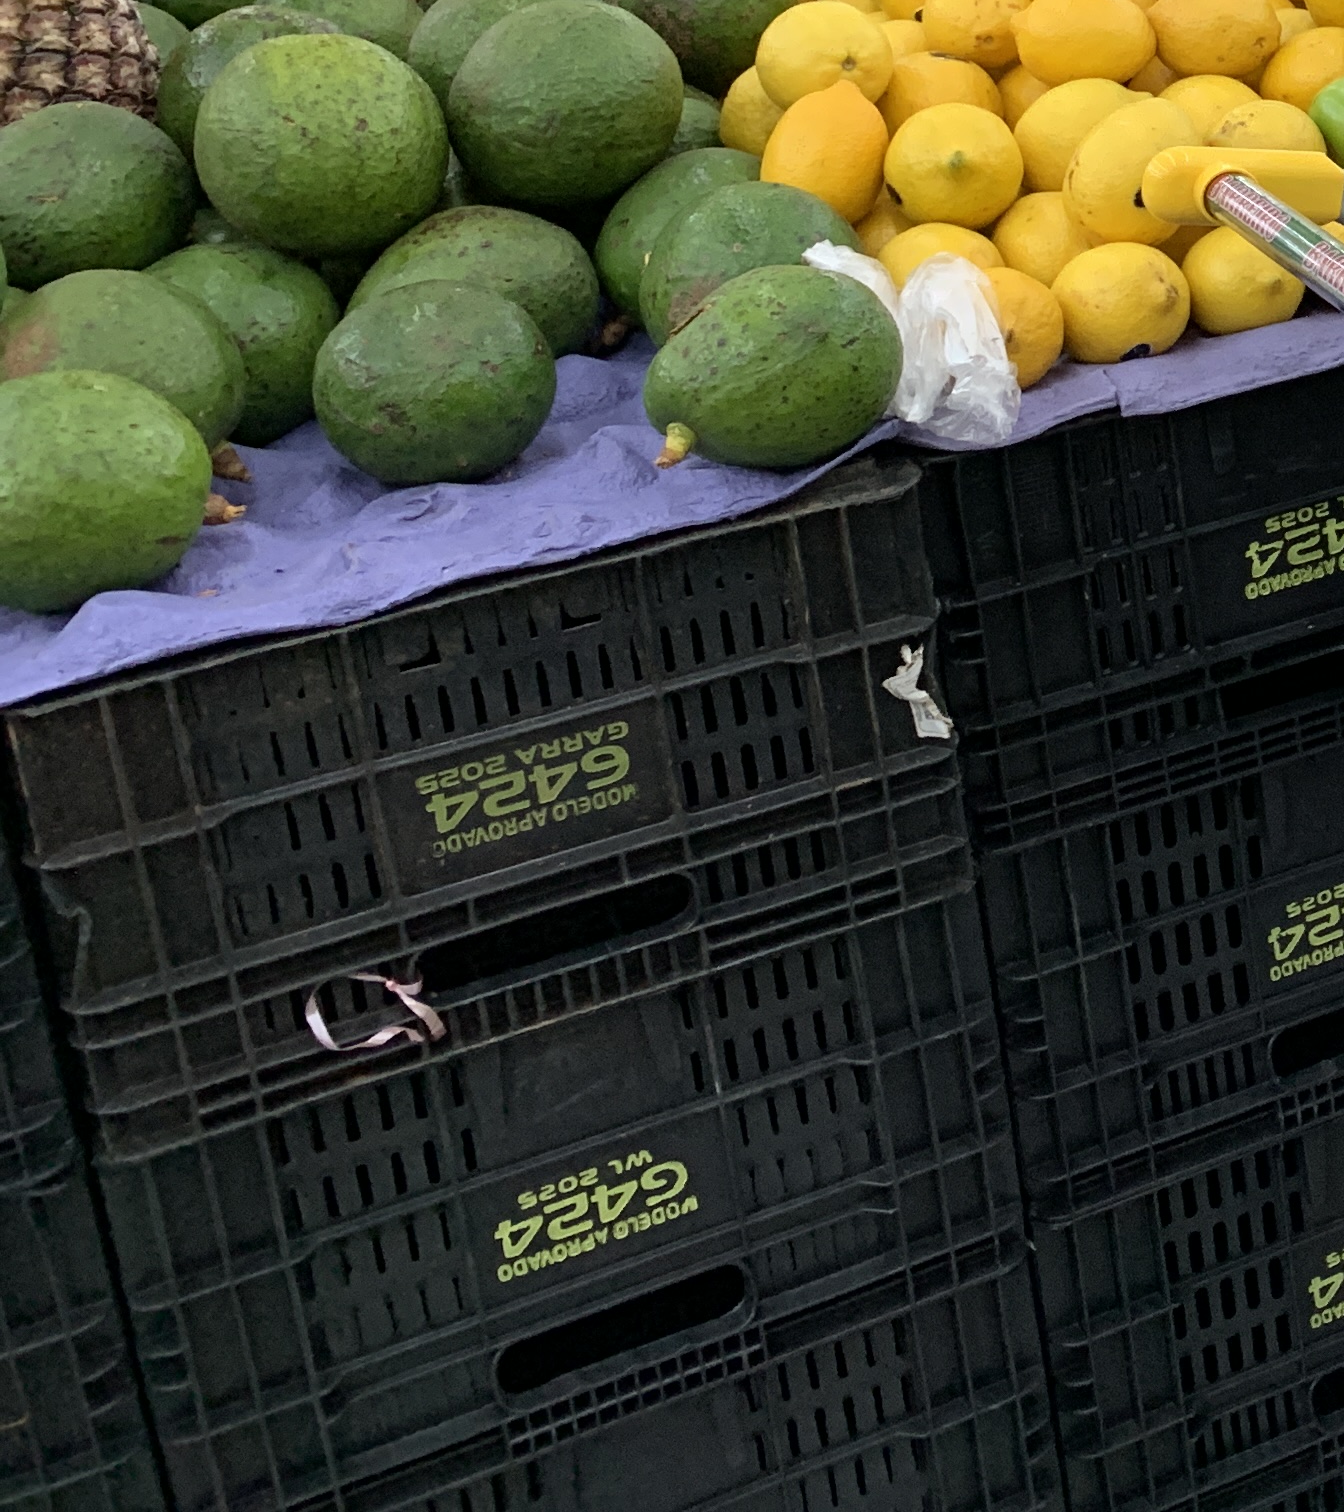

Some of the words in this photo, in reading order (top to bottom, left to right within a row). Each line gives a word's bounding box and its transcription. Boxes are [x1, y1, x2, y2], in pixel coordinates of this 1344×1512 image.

[1264, 500, 1331, 535] 2025
[414, 753, 507, 796] 2025
[516, 1166, 600, 1212] 2025
